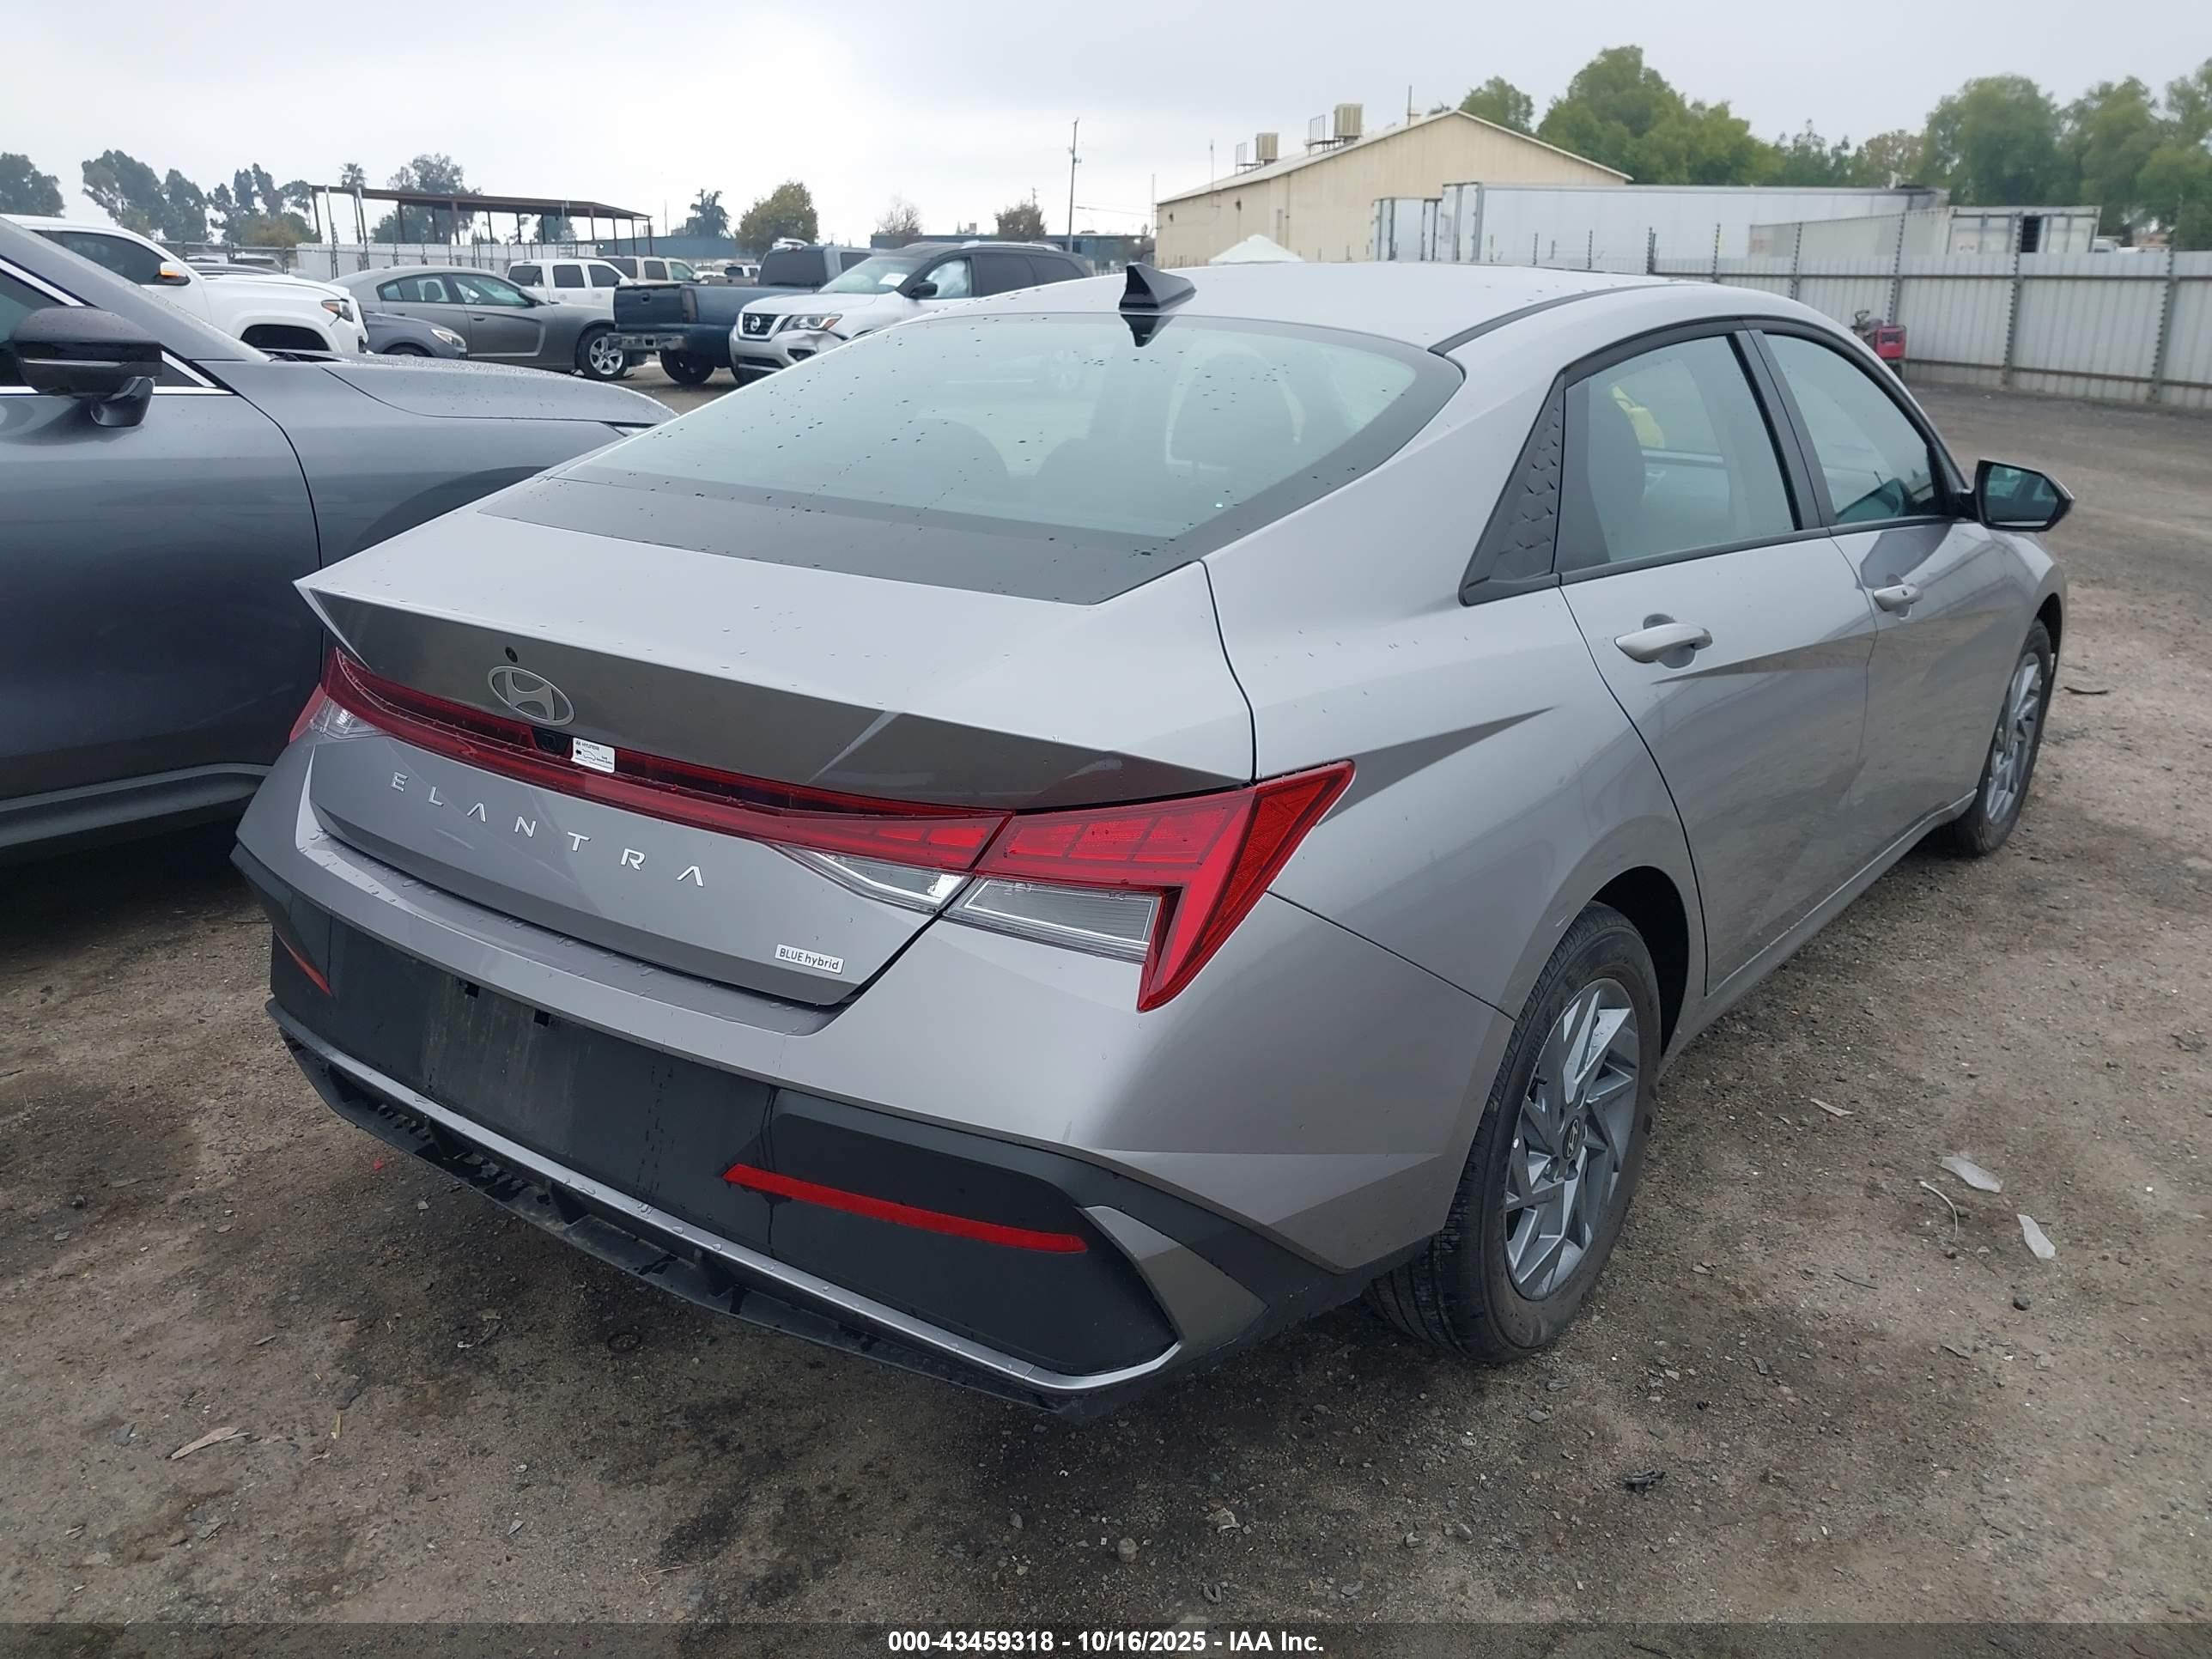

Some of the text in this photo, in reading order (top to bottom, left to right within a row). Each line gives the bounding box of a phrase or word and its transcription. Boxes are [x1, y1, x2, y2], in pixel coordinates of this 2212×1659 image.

[391, 772, 705, 888] ELANTRA
[779, 947, 840, 970] BLUE hybrid
